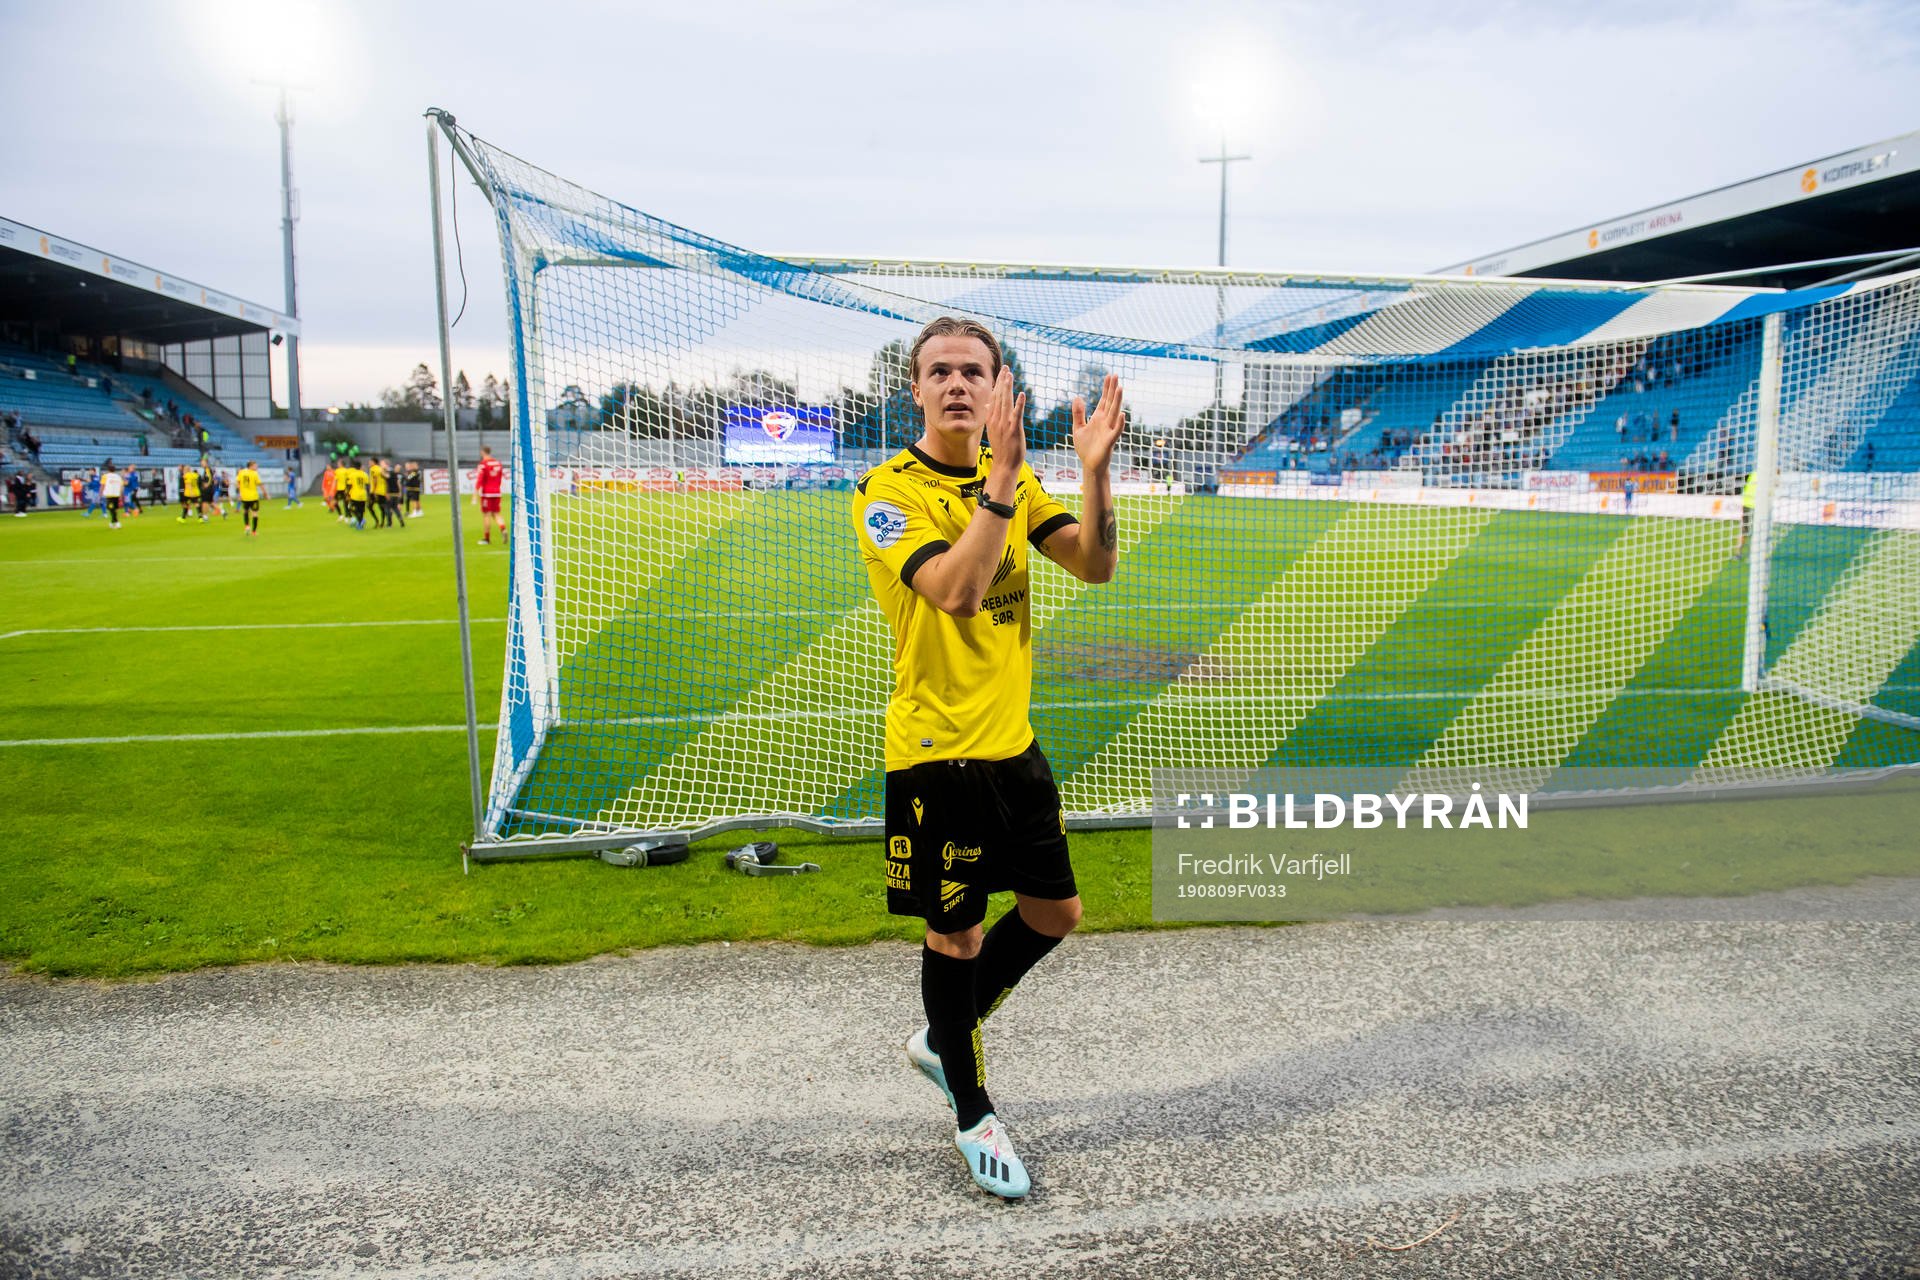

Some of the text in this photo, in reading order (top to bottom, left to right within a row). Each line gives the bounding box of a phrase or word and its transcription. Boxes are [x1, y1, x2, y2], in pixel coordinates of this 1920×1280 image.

[1823, 150, 1897, 183] KOMPLET
[876, 519, 902, 543] OBOS
[979, 589, 1026, 612] REBANK
[992, 610, 1015, 626] SØR
[894, 839, 908, 855] PB
[943, 892, 965, 913] START
